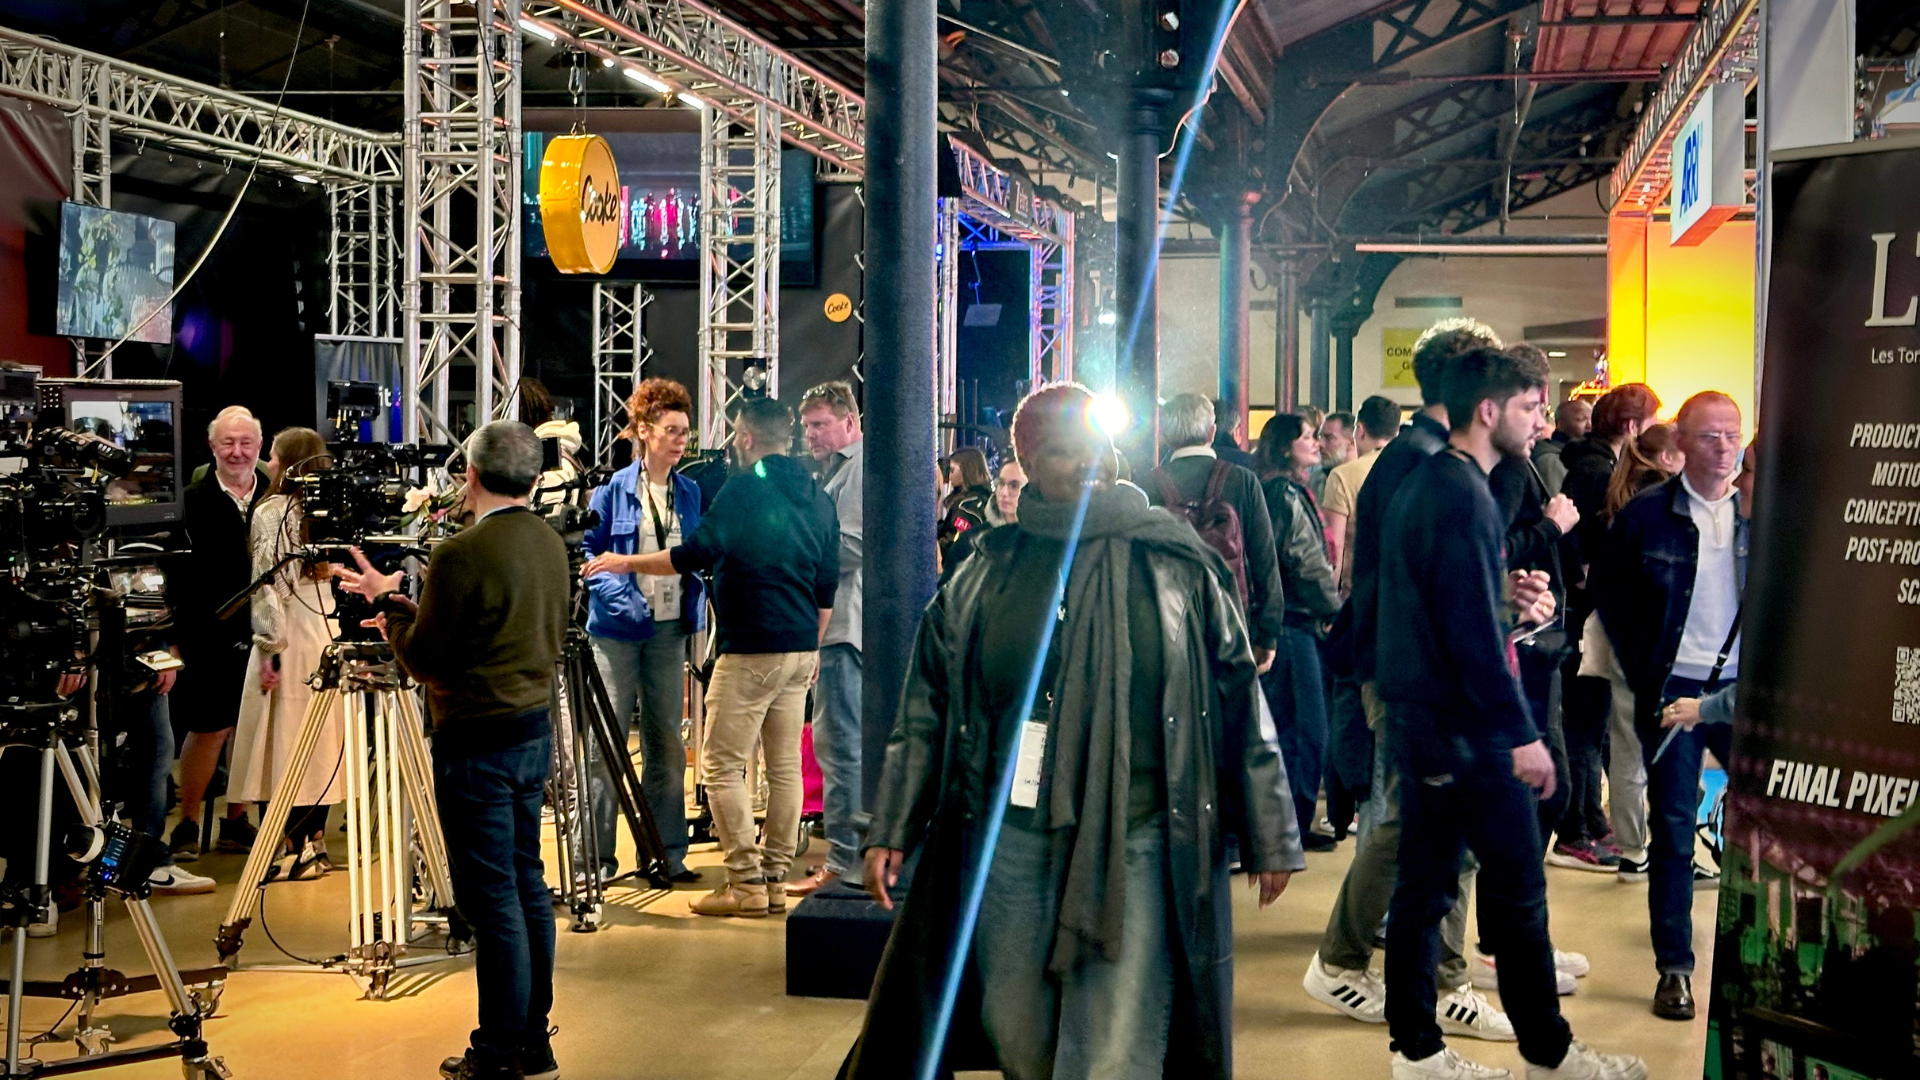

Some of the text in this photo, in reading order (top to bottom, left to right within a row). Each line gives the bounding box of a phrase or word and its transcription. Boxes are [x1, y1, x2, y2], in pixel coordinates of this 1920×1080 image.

[581, 174, 618, 227] Cooke
[1864, 232, 1920, 327] L
[827, 301, 849, 316] Cooke
[1871, 347, 1894, 364] Les
[1766, 758, 1841, 808] FINAL
